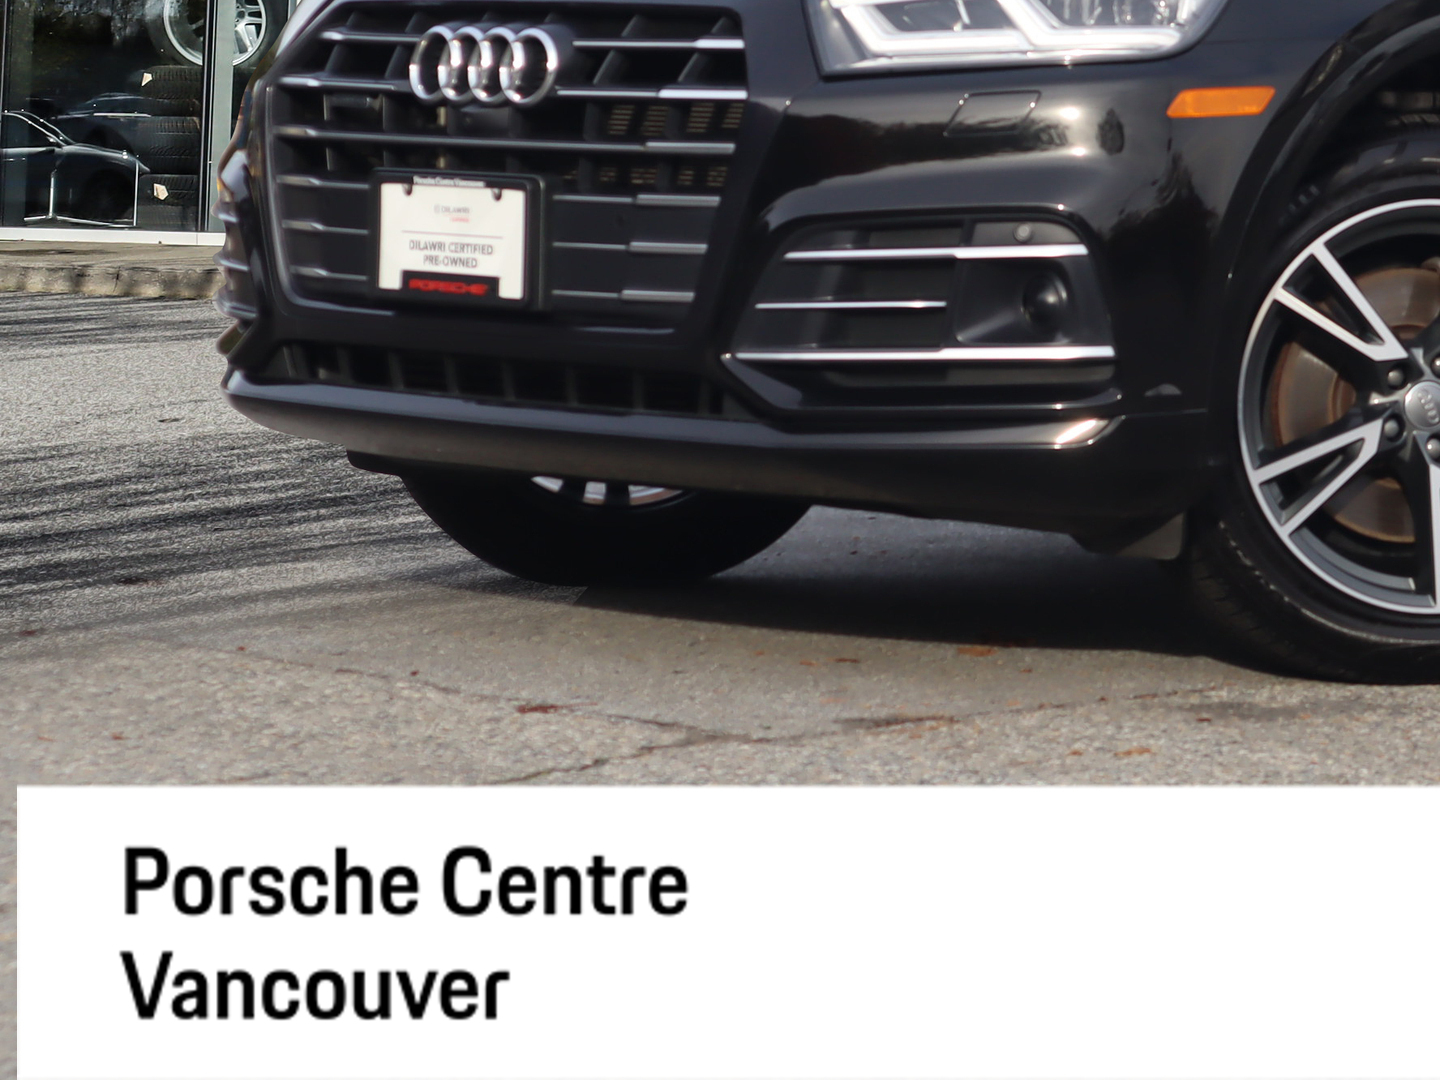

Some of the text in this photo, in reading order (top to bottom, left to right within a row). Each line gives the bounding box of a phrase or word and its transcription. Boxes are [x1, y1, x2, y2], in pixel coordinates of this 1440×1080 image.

[409, 239, 494, 255] DILAWRI CERTIFIED
[423, 255, 478, 268] PRE-OWNED
